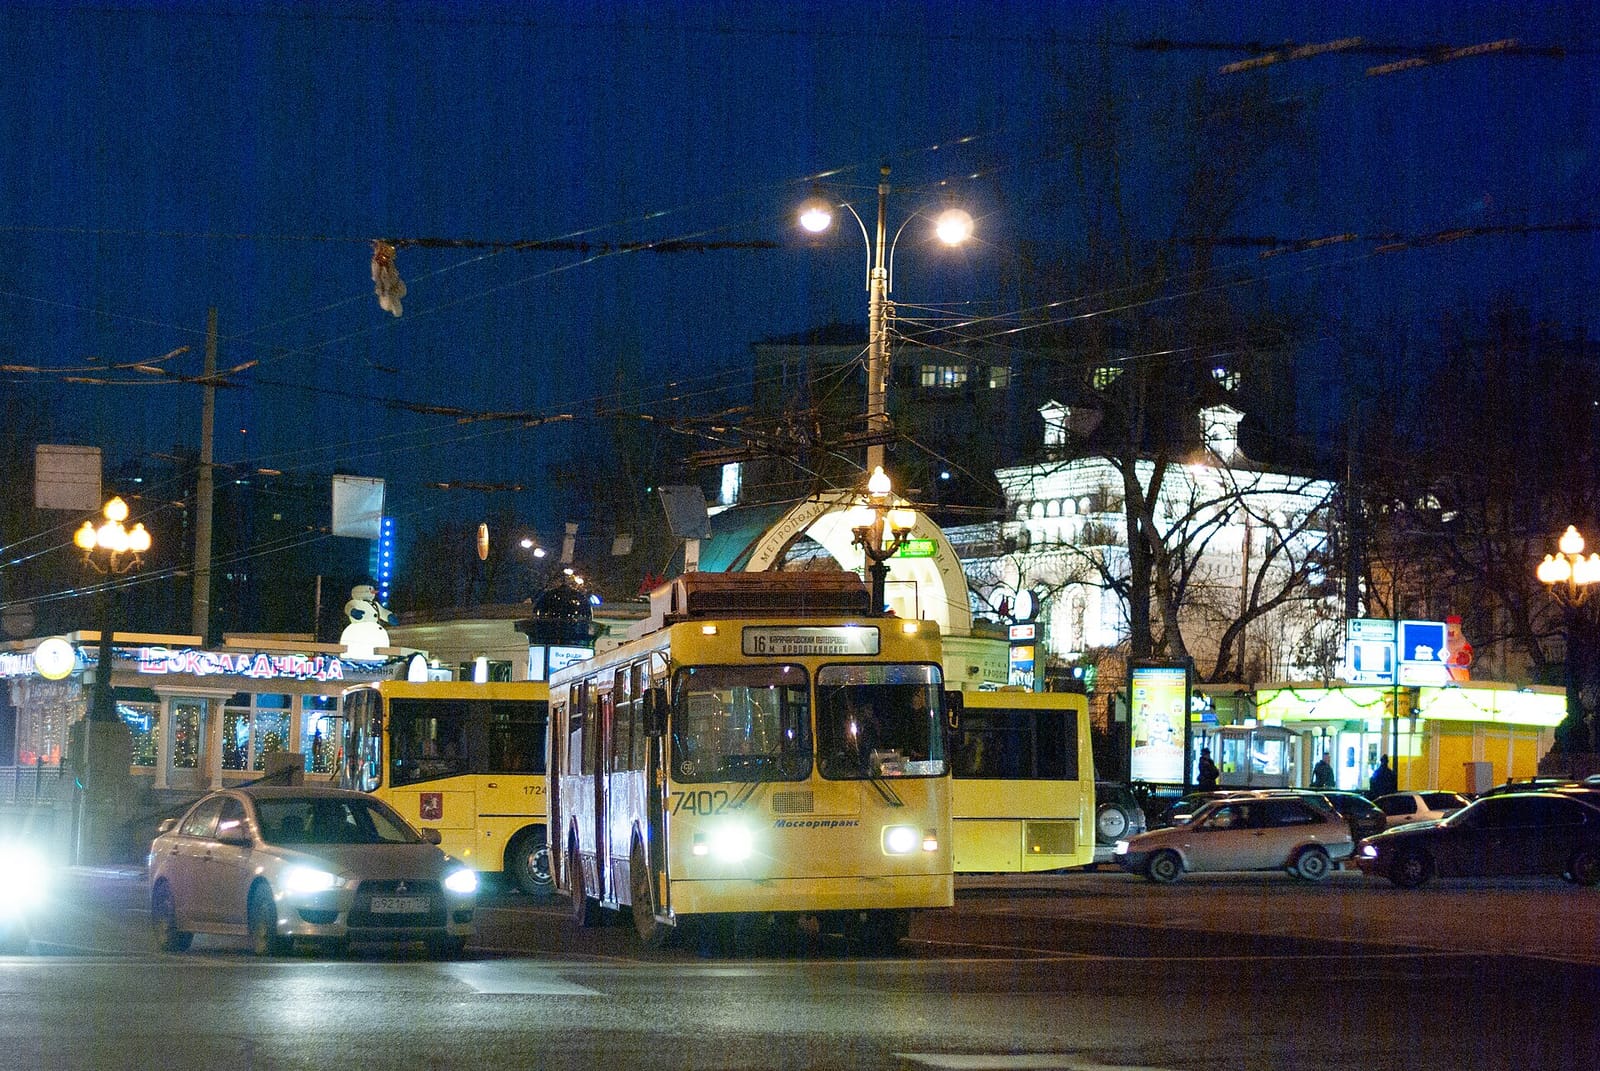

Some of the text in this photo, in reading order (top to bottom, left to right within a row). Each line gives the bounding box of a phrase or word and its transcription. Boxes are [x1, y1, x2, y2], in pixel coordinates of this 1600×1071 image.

[753, 635, 767, 653] 16
[140, 646, 345, 681] ШОКОЛАДНИЦА
[671, 790, 729, 816] 7402
[774, 818, 860, 829] Мосгортранс
